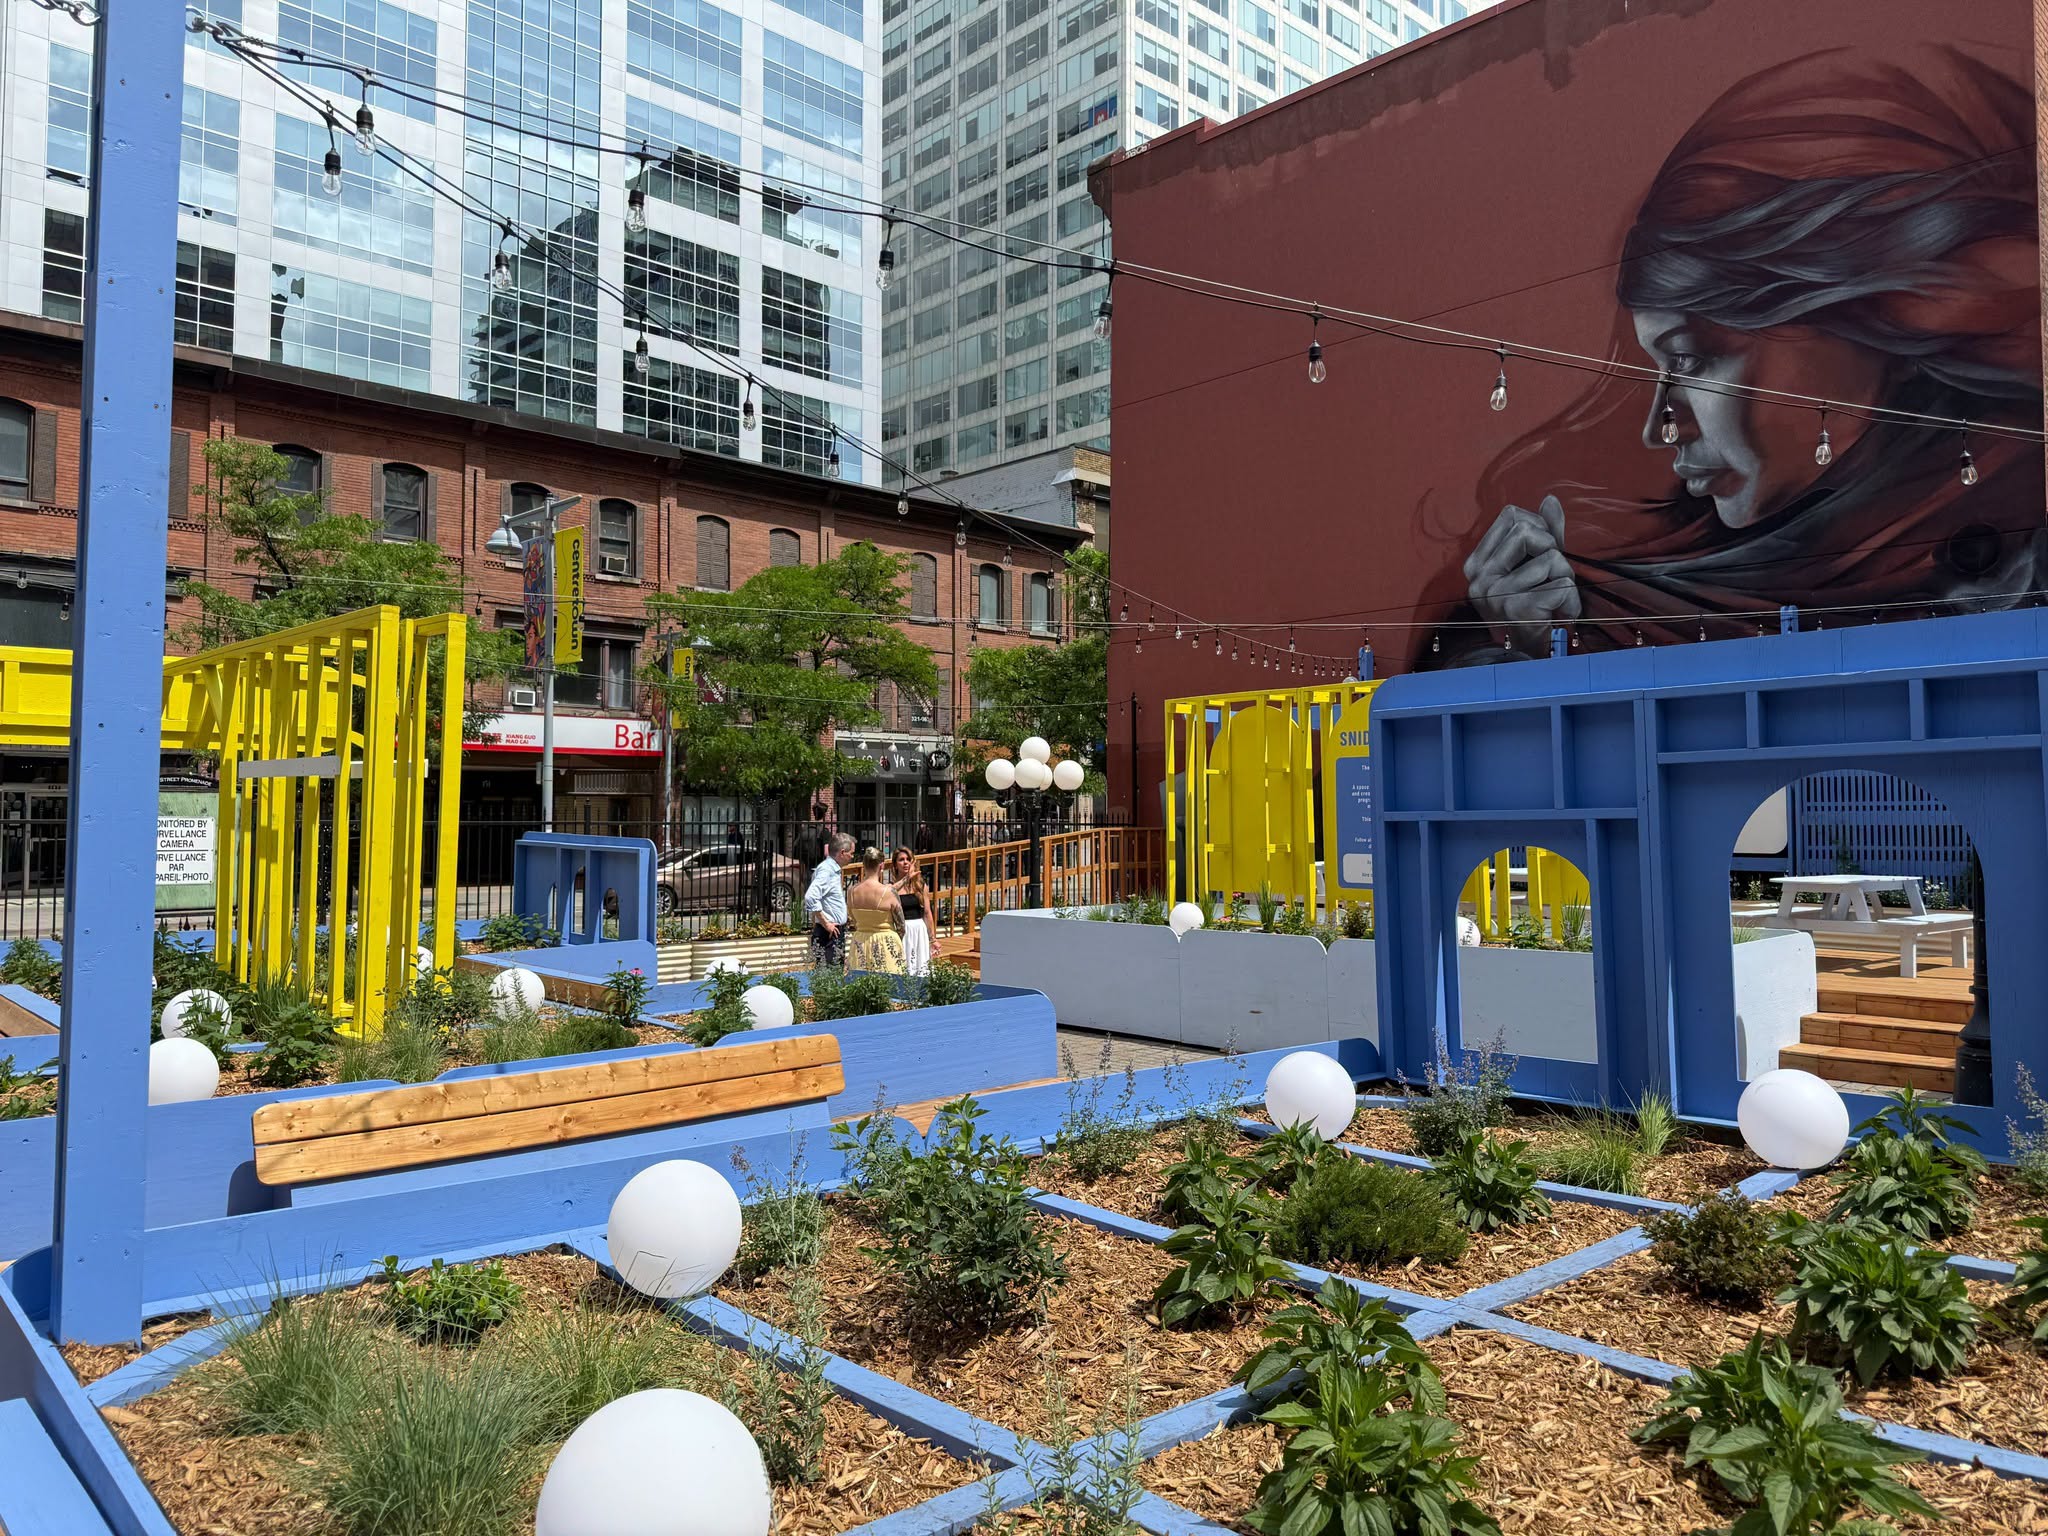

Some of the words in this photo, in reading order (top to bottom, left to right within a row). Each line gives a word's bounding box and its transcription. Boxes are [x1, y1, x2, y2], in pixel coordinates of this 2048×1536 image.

[571, 538, 580, 650] centretown
[615, 724, 656, 749] Bar
[197, 820, 207, 828] BY
[160, 840, 194, 848] CAMERA
[169, 863, 184, 871] PAR
[182, 872, 209, 881] PHOTO
